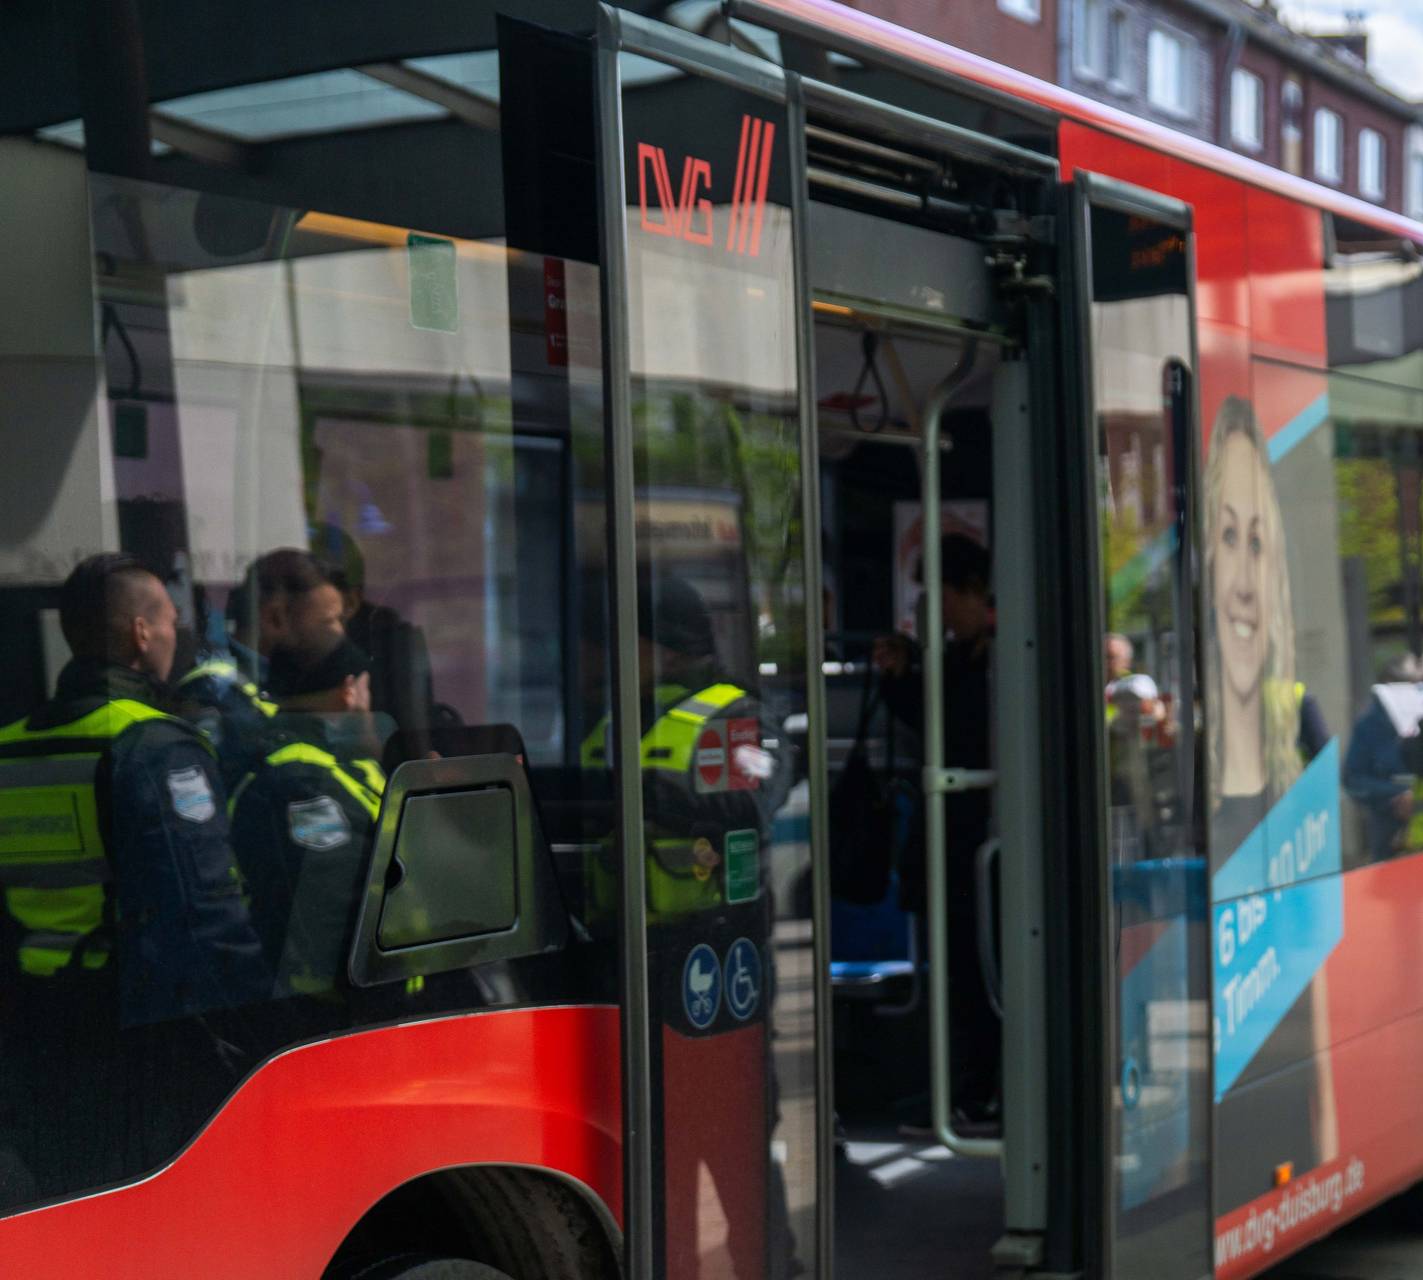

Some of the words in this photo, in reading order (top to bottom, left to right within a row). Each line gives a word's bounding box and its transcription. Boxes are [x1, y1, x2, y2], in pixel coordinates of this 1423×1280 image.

[637, 142, 713, 247] DVG
[1218, 908, 1235, 967] 6
[1295, 808, 1328, 874] Uhr
